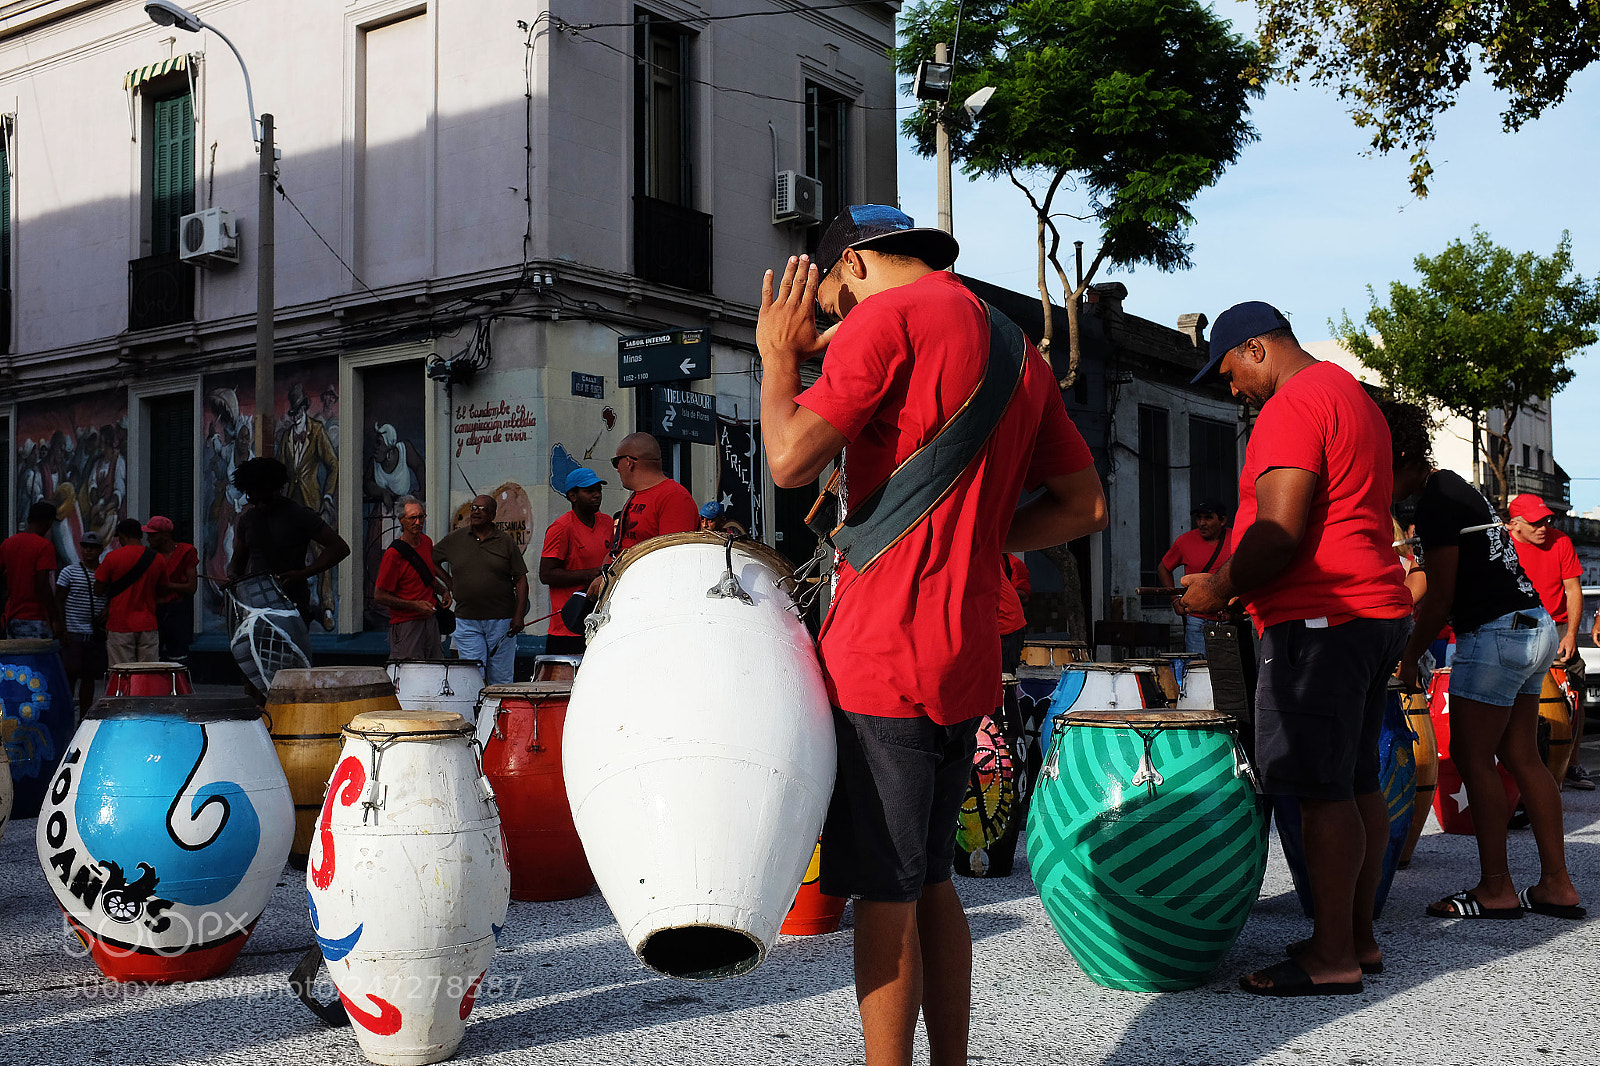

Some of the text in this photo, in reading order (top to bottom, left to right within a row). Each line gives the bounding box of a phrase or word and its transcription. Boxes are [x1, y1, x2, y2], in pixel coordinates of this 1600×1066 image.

[626, 335, 671, 347] SABOR INTENSO
[623, 354, 643, 364] Minas
[456, 405, 467, 420] El
[456, 438, 464, 458] y
